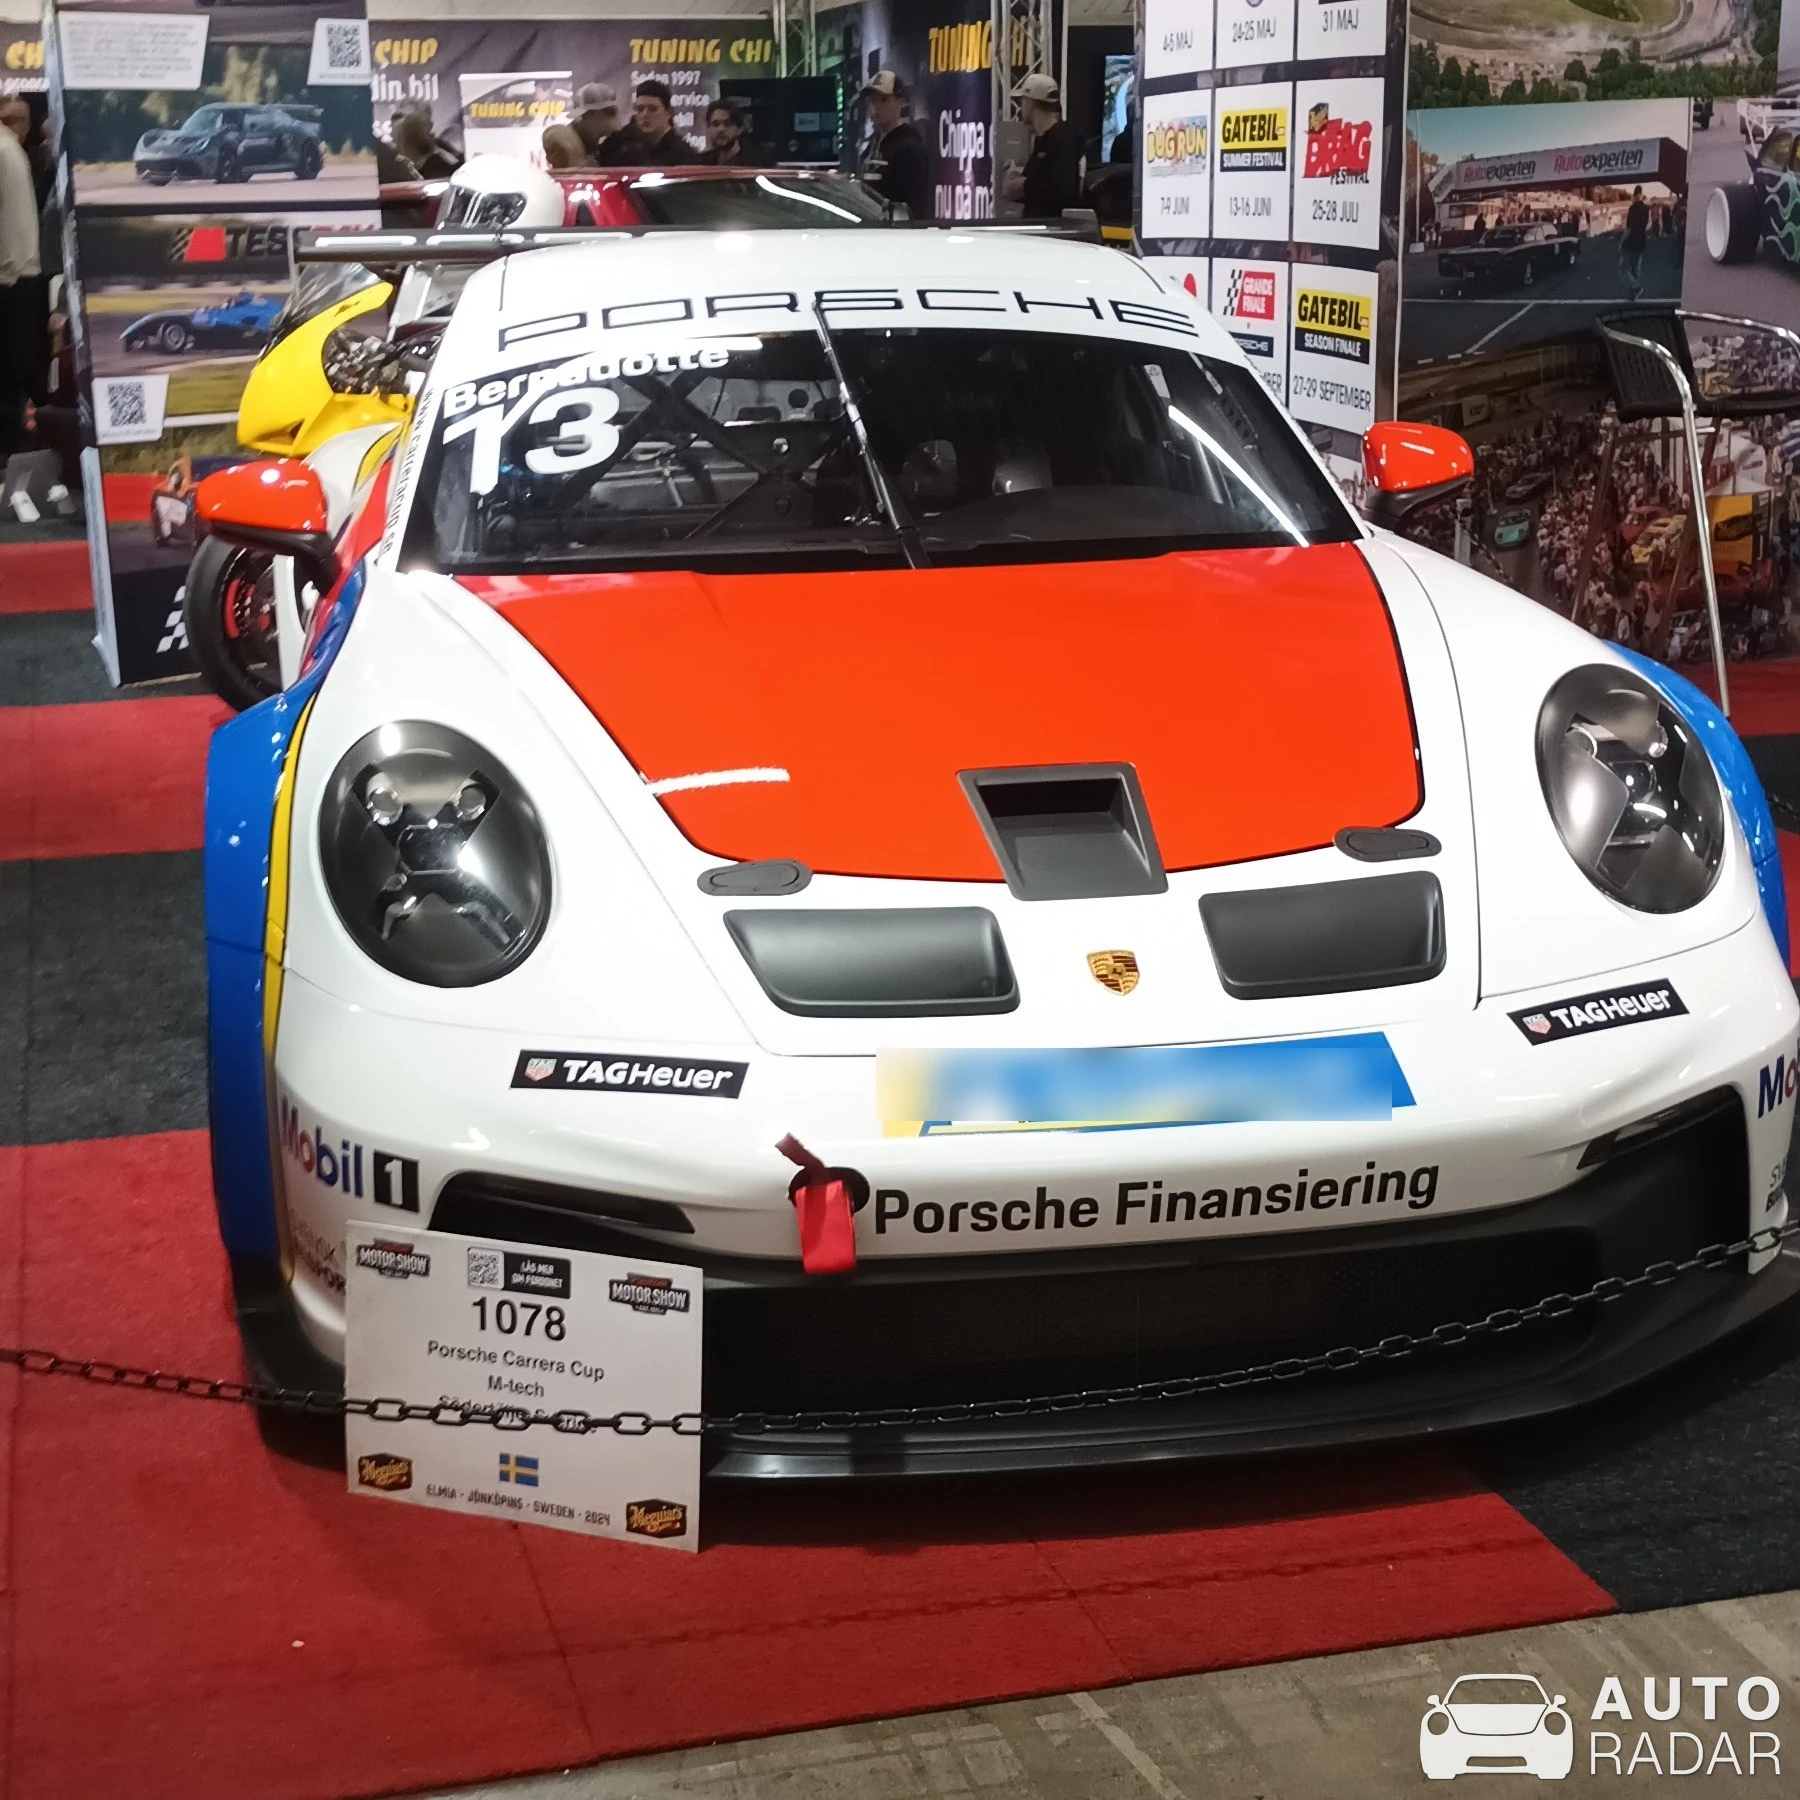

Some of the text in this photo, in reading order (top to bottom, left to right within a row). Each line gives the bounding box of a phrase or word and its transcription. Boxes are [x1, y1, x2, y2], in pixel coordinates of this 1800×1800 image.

[1256, 17, 1276, 39] MAJ
[1323, 7, 1359, 32] 31 MAJ
[375, 38, 439, 66] CHIP
[630, 38, 721, 64] TUNING
[929, 20, 992, 74] TUNING
[1175, 29, 1193, 51] MAJ
[408, 73, 439, 102] bil
[671, 70, 701, 86] 1997
[469, 101, 525, 119] TUNING
[939, 109, 986, 171] Chippa
[1222, 113, 1279, 144] GATEBIL
[1463, 159, 1536, 184] Autoexperten
[1555, 148, 1644, 174] Autoexperten
[1252, 196, 1272, 217] JUNI
[1312, 199, 1360, 223] 25-28 JULI
[499, 288, 1200, 352] PORSCHE
[1298, 293, 1362, 331] GATEBIL
[1304, 332, 1361, 358] SEASON FINALE
[1293, 374, 1372, 413] 27-29 SEPTEMBER
[442, 386, 621, 496] 13
[280, 1092, 404, 1206] Mobil 1
[874, 1160, 1440, 1236] Porsche Finansiering
[358, 1246, 396, 1269] MOTOR
[396, 1254, 429, 1273] SHOW
[611, 1282, 652, 1303] MOTOR
[652, 1288, 687, 1309] SHOW
[471, 1296, 567, 1342] 1078
[427, 1339, 605, 1383] Porsche Carrera Cup
[487, 1374, 545, 1398] M-tech
[426, 1483, 611, 1526] ELMIA JÖNKÖPING SWEDEN 2024
